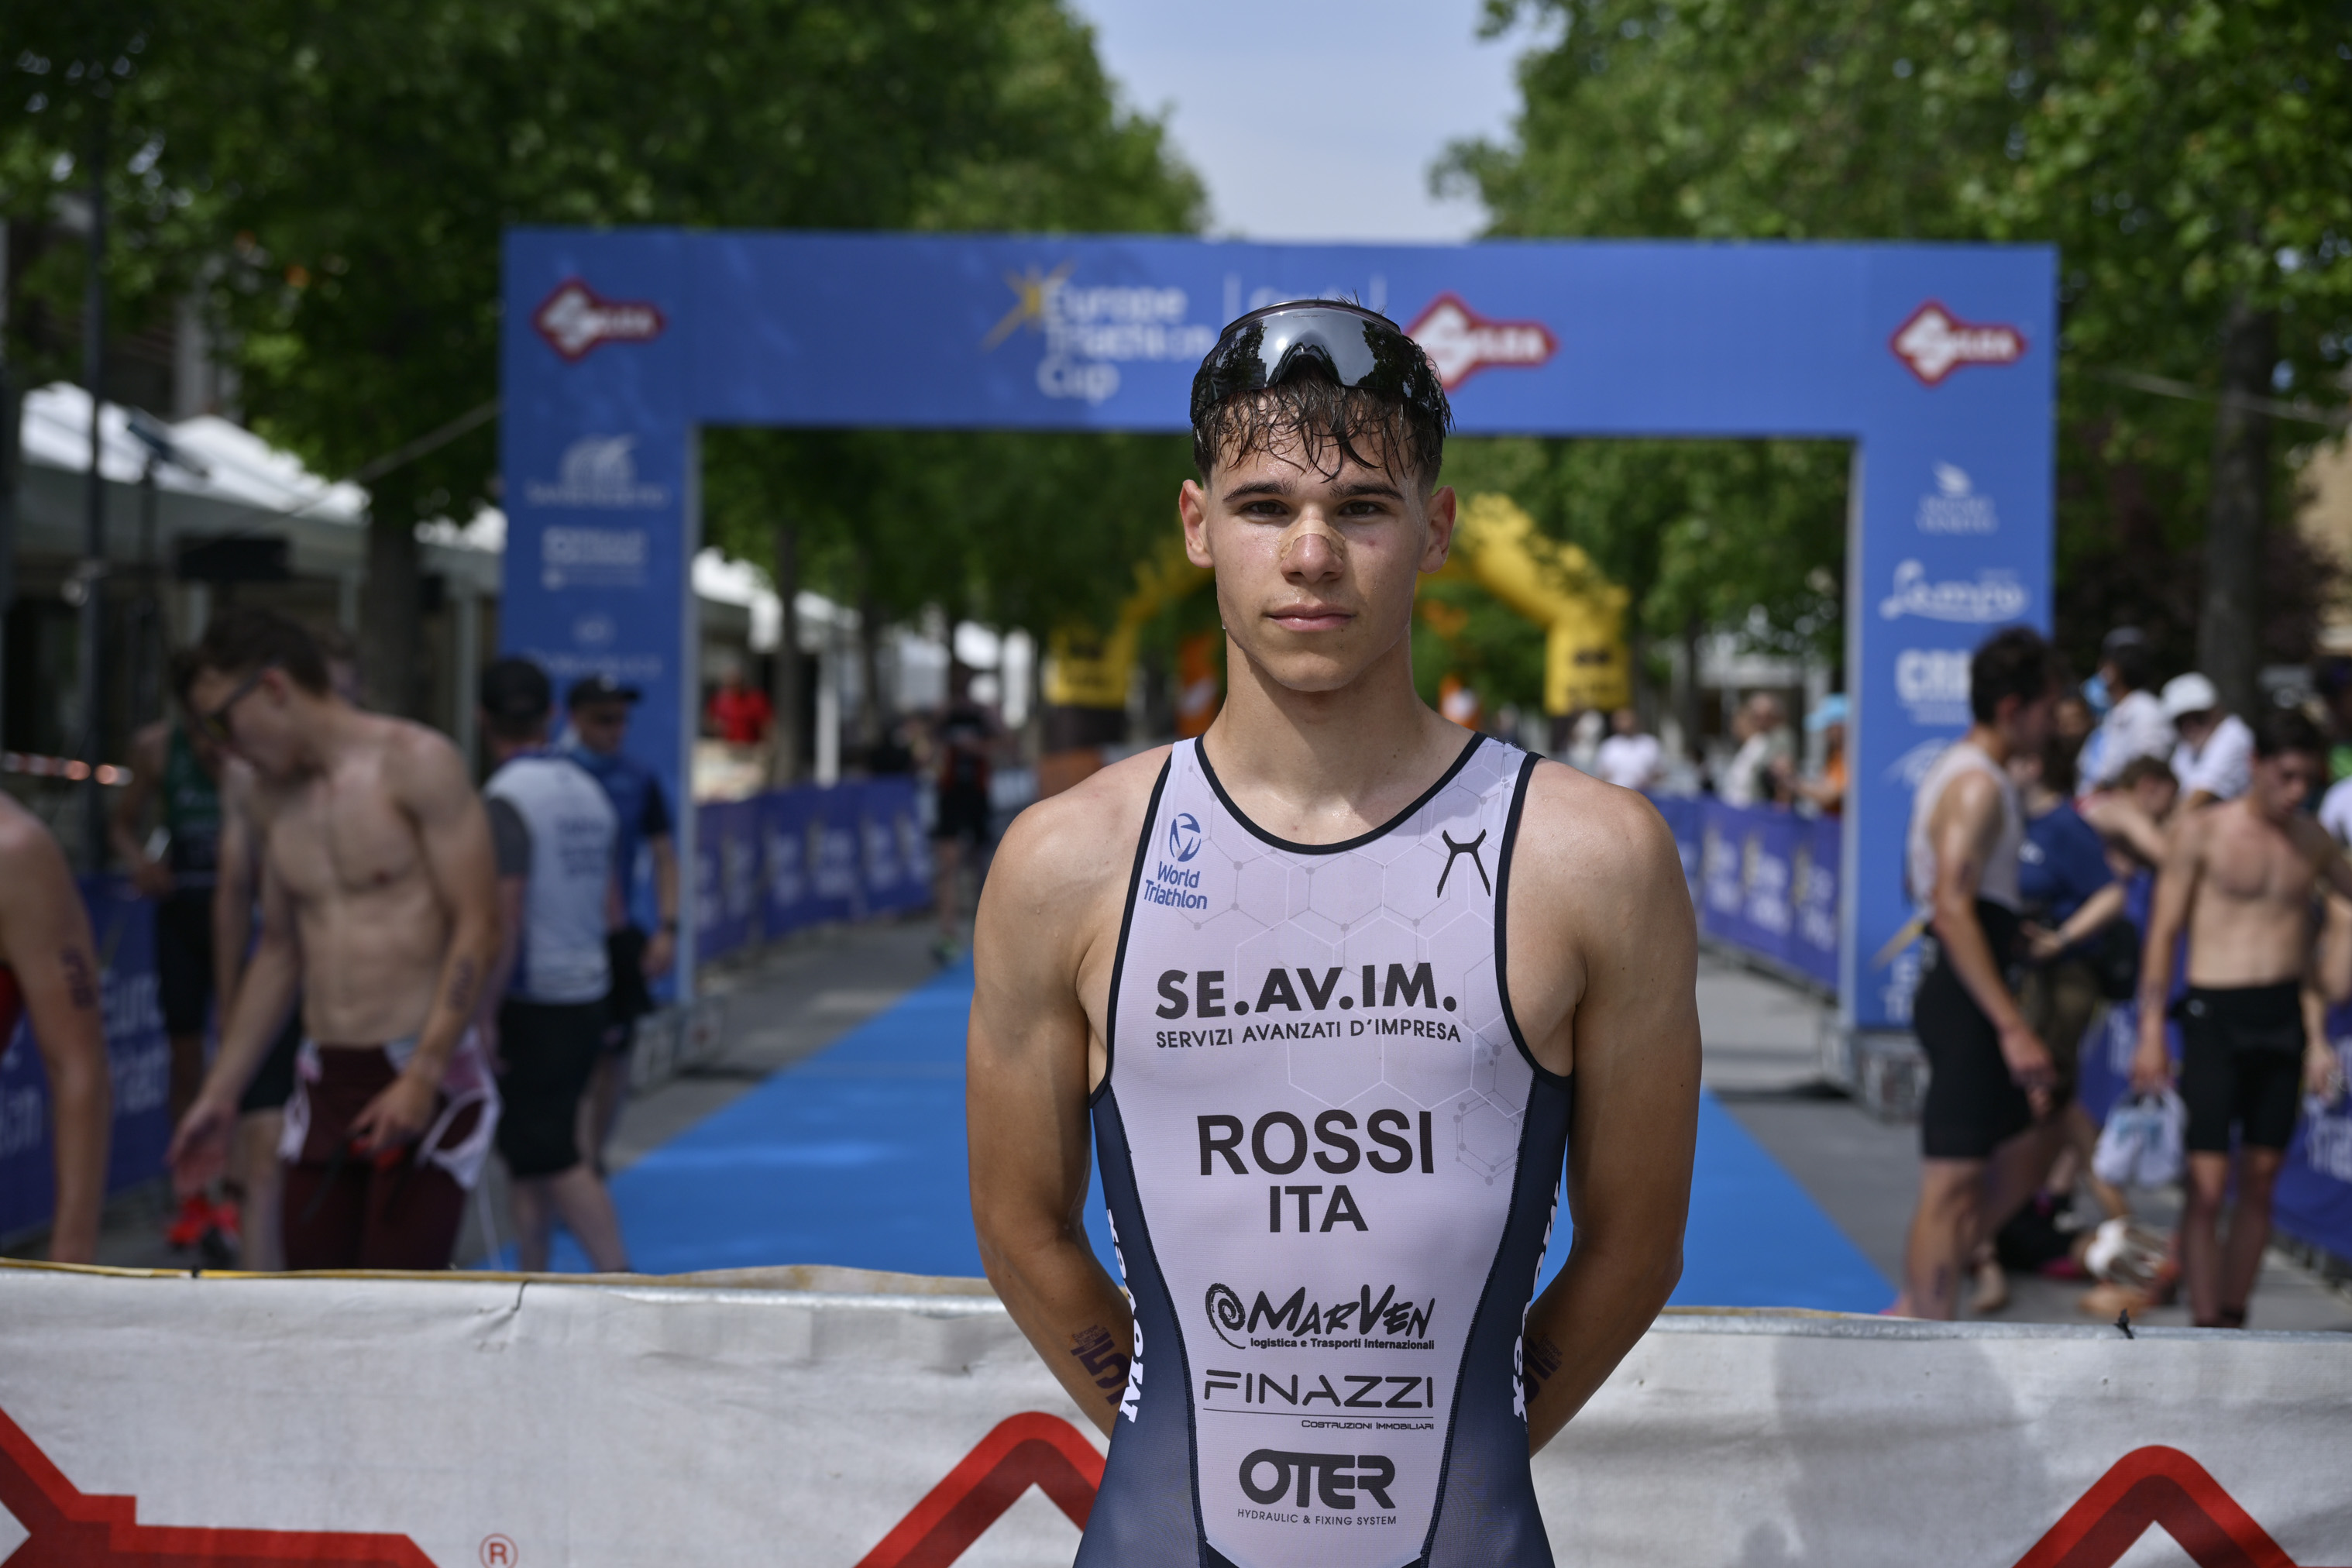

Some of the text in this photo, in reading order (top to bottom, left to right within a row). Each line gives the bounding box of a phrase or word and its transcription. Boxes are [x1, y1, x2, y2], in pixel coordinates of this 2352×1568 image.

[1157, 861, 1200, 889] World
[1144, 879, 1208, 910] Triathlon
[1156, 962, 1457, 1020] SE.AV.IM.
[1156, 1018, 1461, 1048] SERVIZI AVANZATI D'IMPRESA
[1197, 1109, 1434, 1175] ROSSI
[1269, 1185, 1369, 1233] ITA
[1250, 1338, 1297, 1349] logistica
[1310, 1338, 1361, 1350] Trasporti
[1364, 1338, 1435, 1350] Internazionali
[1204, 1369, 1433, 1408] FINAZZI
[1239, 1448, 1396, 1510] OTER
[1237, 1508, 1397, 1525] HYDRAULIC & FIXING SYSTEM
